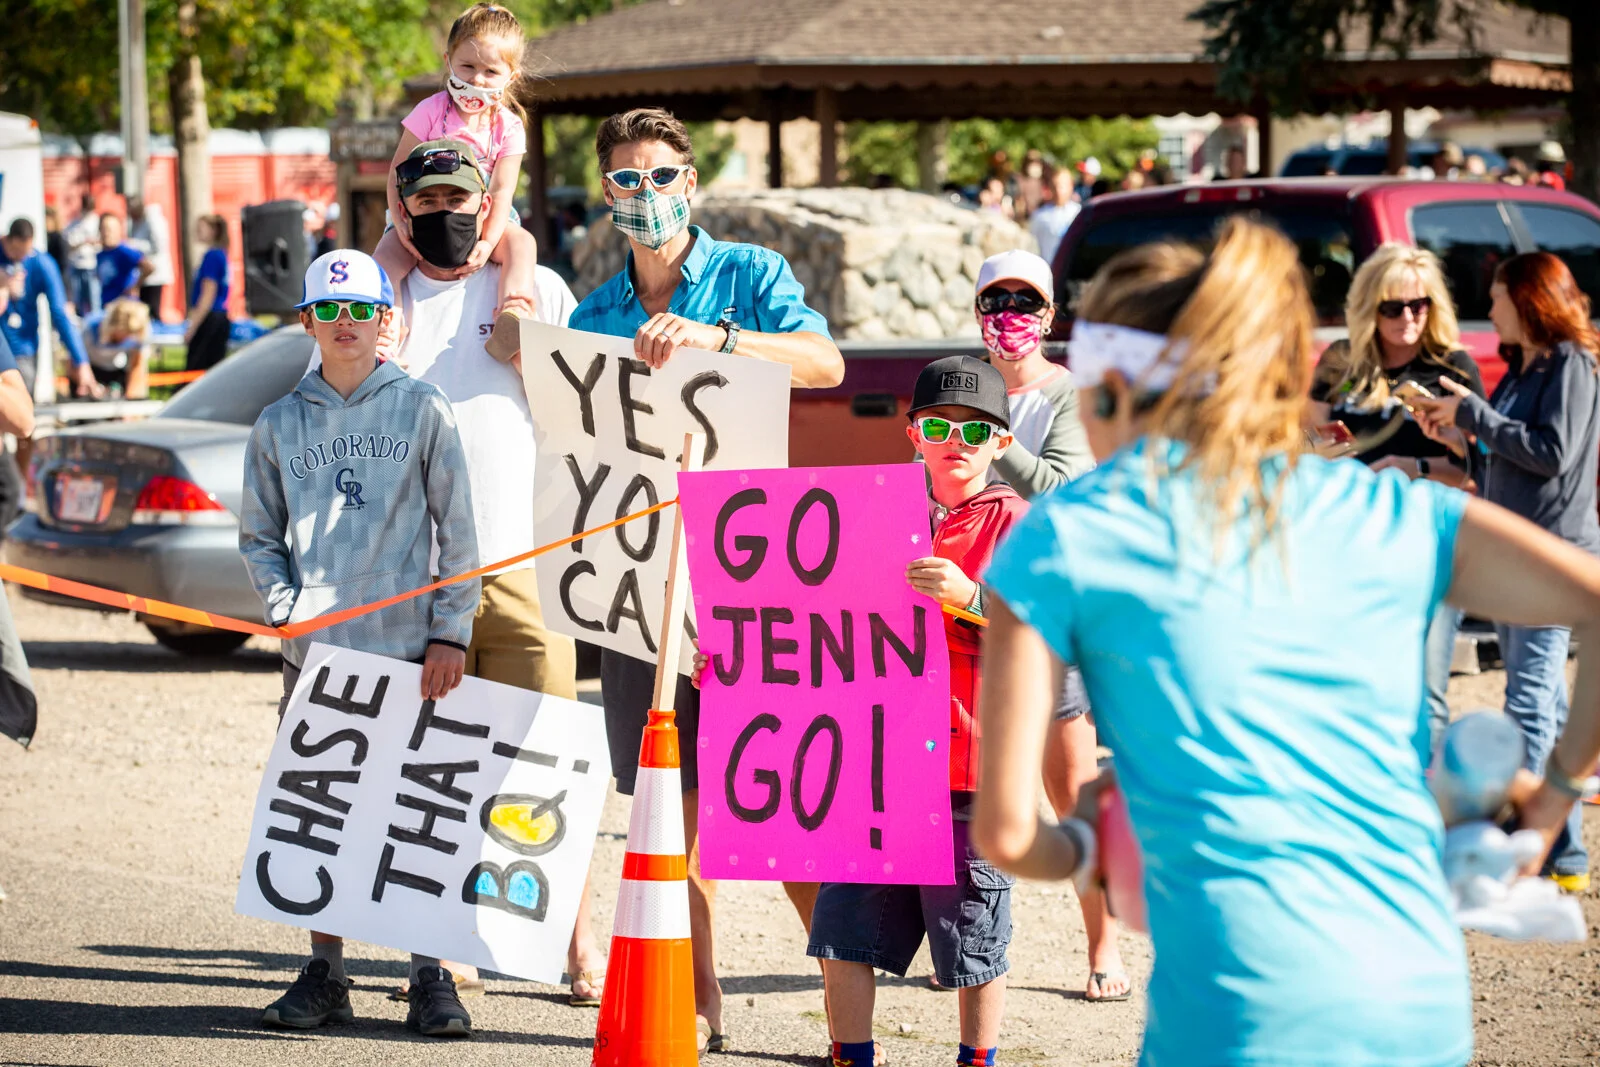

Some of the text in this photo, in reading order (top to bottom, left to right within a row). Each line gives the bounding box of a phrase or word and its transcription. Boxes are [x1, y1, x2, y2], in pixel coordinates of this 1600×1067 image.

[329, 260, 349, 284] S
[289, 434, 410, 480] COLORADO
[550, 349, 730, 467] YES
[335, 467, 366, 507] CR
[714, 487, 841, 587] GO
[559, 559, 700, 655] CA
[711, 604, 927, 689] JENN
[255, 665, 391, 917] CHASE
[371, 698, 491, 904] THAT
[724, 703, 885, 851] GO!
[461, 740, 590, 923] BQ!
